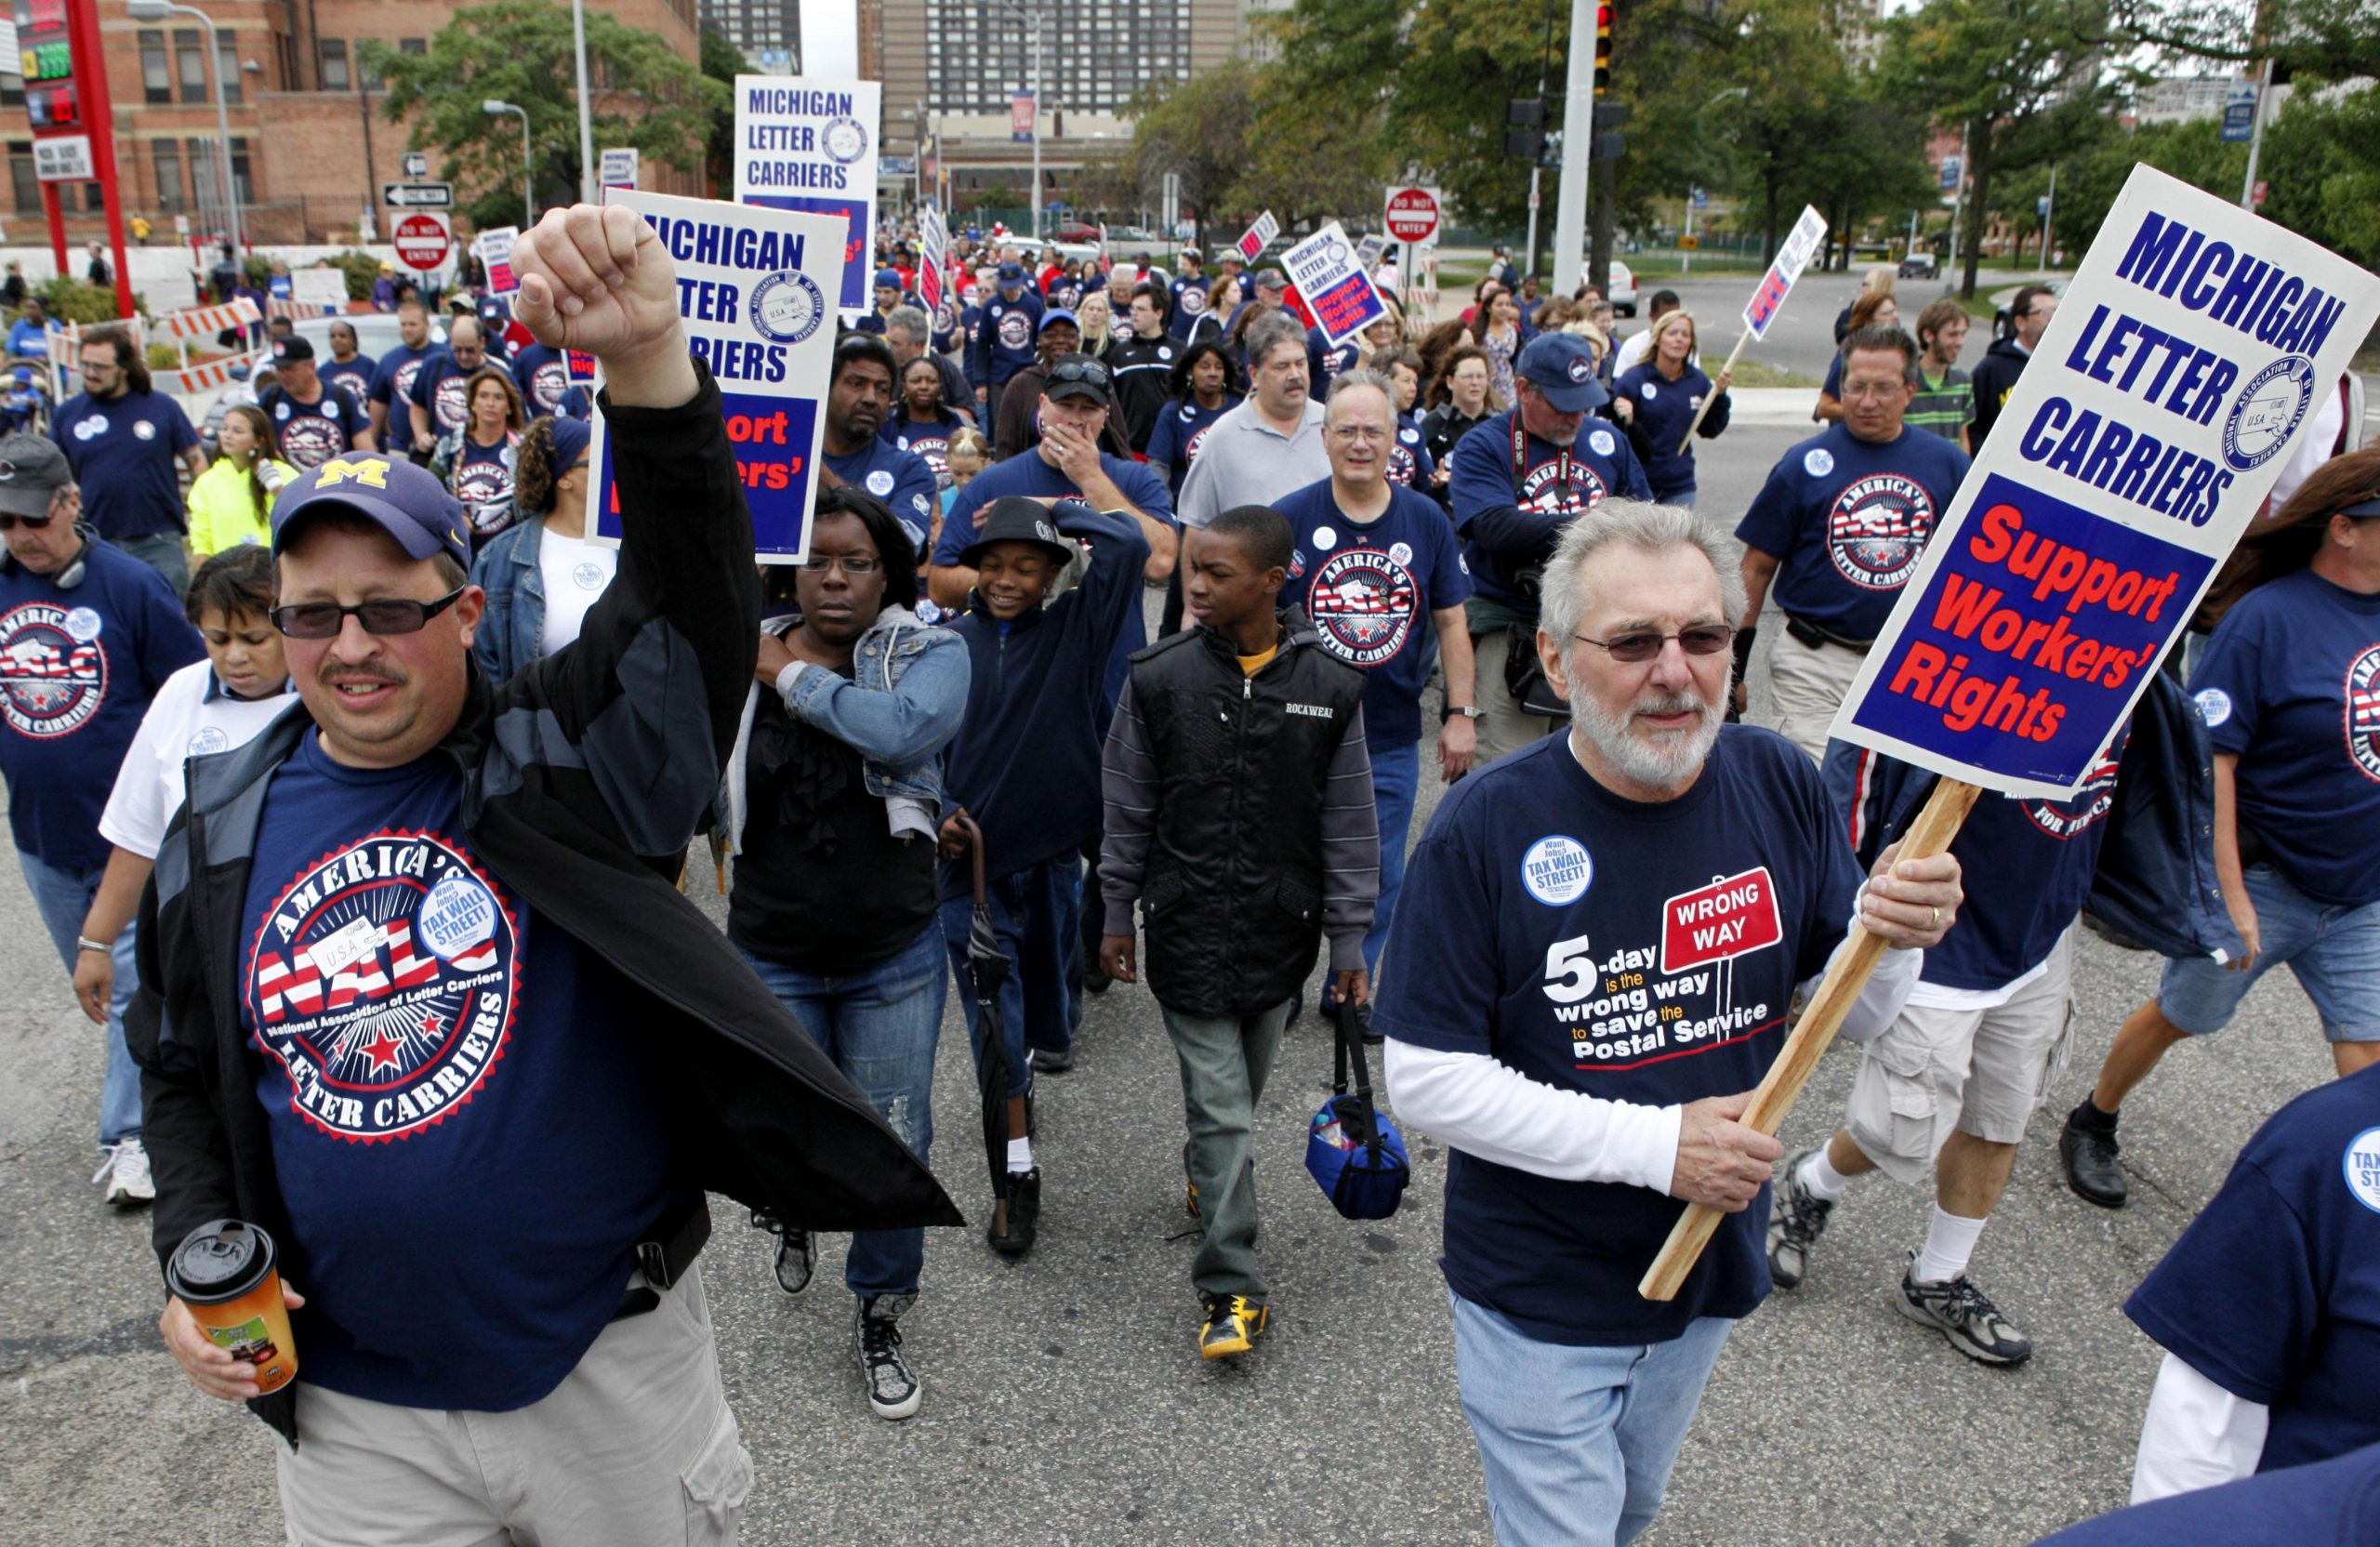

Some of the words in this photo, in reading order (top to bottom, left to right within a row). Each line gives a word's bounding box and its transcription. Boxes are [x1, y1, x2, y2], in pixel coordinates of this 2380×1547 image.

[748, 88, 853, 116] MICHIGAN
[748, 126, 814, 152] LETTER
[747, 161, 847, 191] CARRIERS
[1394, 197, 1408, 209] DO
[1412, 198, 1432, 209] NOT
[400, 224, 416, 235] DO
[419, 224, 441, 235] NOT
[643, 214, 805, 271] ICHIGAN
[1395, 222, 1427, 233] ENTER
[405, 250, 439, 261] ENTER
[1289, 232, 1334, 268] MICHIGAN
[1296, 256, 1328, 281] LETTER
[1304, 262, 1349, 295] CARRIERS
[2114, 210, 2346, 359] MICHIGAN
[675, 277, 739, 324] TER
[570, 359, 595, 376] Rig
[690, 335, 787, 383] RIERS
[2065, 304, 2240, 427] LETTER
[2239, 361, 2290, 409] ASSOCIATION
[2290, 393, 2309, 428] LETTER
[912, 441, 948, 455] MERICA
[1514, 430, 1524, 450] EOS
[2224, 414, 2239, 456] NATIONAL
[2249, 434, 2288, 467] CARRIERS
[315, 458, 390, 490] M
[2019, 395, 2233, 527] CARRIERS
[1842, 479, 1926, 510] AMERICA'S
[1833, 509, 1930, 538] NALC
[1396, 545, 1410, 558] WE
[1833, 545, 1872, 584] LETTER
[1969, 504, 2180, 623] Support
[1325, 553, 1407, 584] AMERICA'S
[1315, 584, 1411, 613] NALC
[1316, 619, 1355, 660] LETTER
[1356, 620, 1407, 662] CARRIERS
[1932, 573, 2156, 689] Workers'
[1887, 641, 2067, 743] Rights
[33, 687, 99, 733] CARRIERS
[2034, 806, 2064, 833] FOR
[1544, 840, 1566, 849] Want
[1544, 848, 1567, 858] Jobs?
[1527, 859, 1552, 877] TAX
[1552, 851, 1586, 870] WALL
[1535, 865, 1585, 889] STREET!
[434, 882, 456, 897] Want
[436, 891, 459, 908] Jobs?
[1676, 883, 1760, 926] WRONG
[422, 909, 449, 934] TAX
[445, 889, 485, 919] WALL
[434, 905, 489, 945] STREET!
[1693, 917, 1747, 951] WAY
[1554, 988, 1648, 1023] wrong
[1654, 972, 1710, 1001] way
[1606, 978, 1619, 993] is
[1620, 972, 1644, 989] the
[266, 1016, 317, 1038] National
[390, 994, 403, 1008] of
[406, 983, 443, 1004] Letter
[446, 971, 504, 993] Carriers
[1572, 1026, 1587, 1040] to
[1591, 1009, 1657, 1038] save
[1660, 1005, 1683, 1022] the
[1573, 1025, 1665, 1060] Postal
[1673, 1002, 1767, 1043] Service
[374, 991, 503, 1128] CARRIERS
